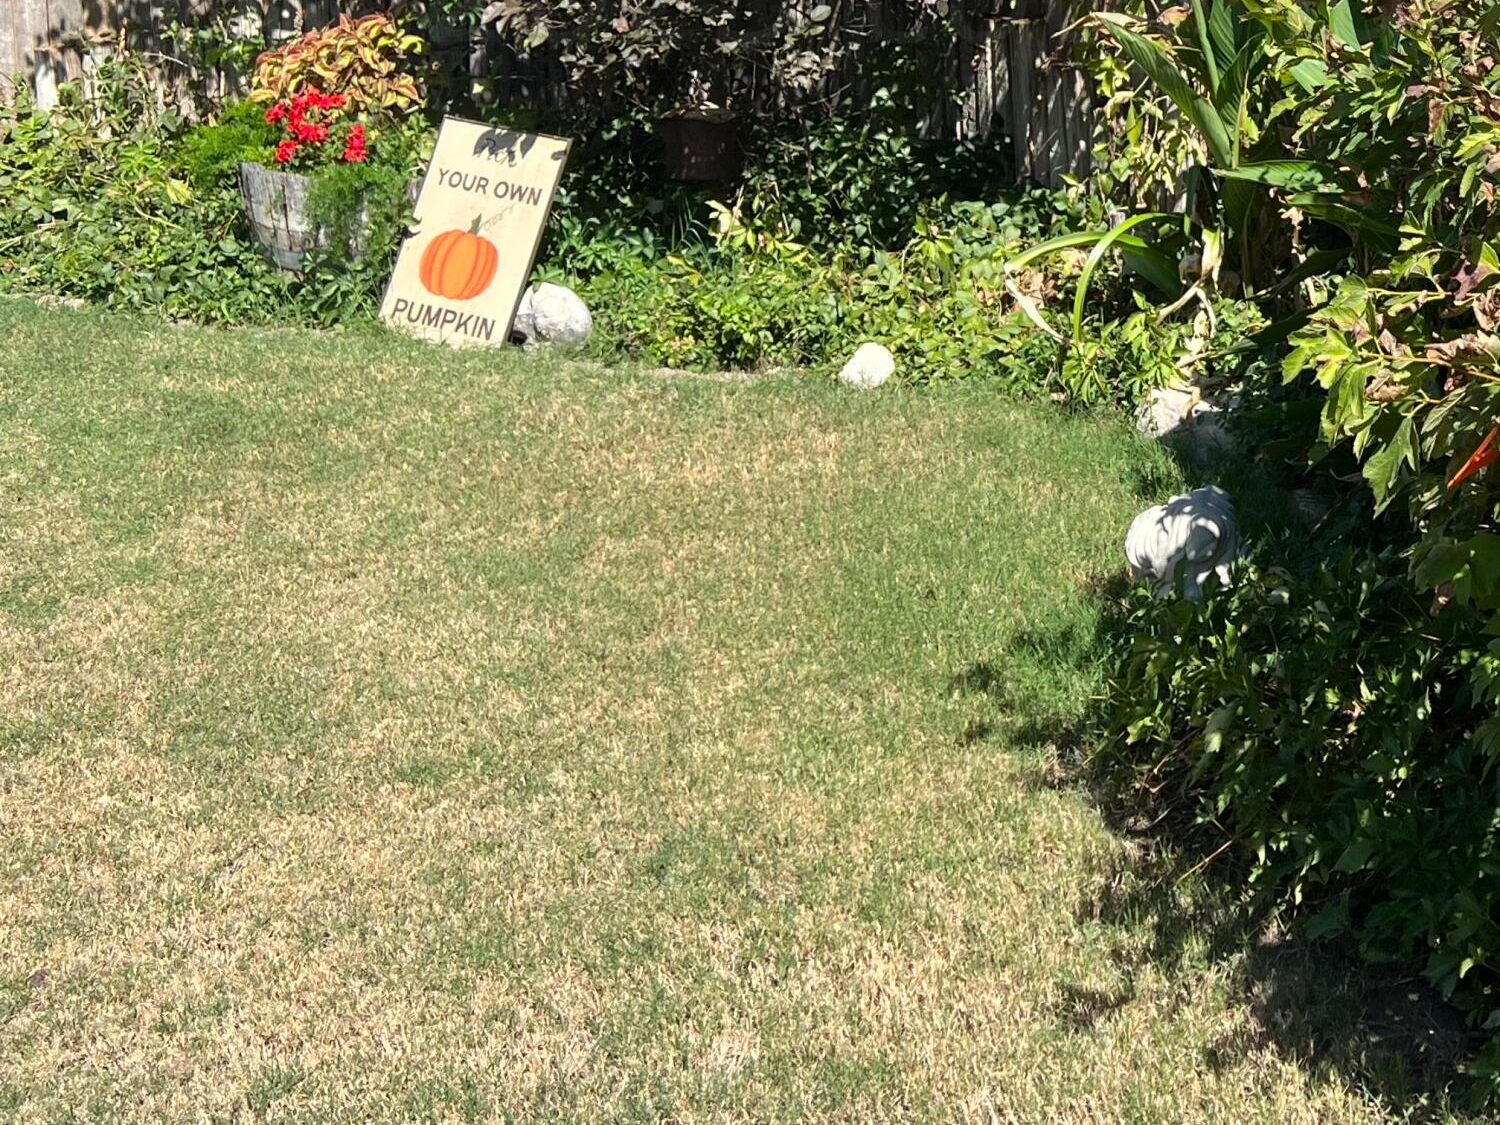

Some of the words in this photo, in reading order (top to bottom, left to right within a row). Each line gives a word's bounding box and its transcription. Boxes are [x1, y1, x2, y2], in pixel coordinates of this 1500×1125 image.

[438, 168, 489, 195] YOUR
[493, 181, 543, 206] OWN
[390, 298, 496, 341] PUMPKIN
